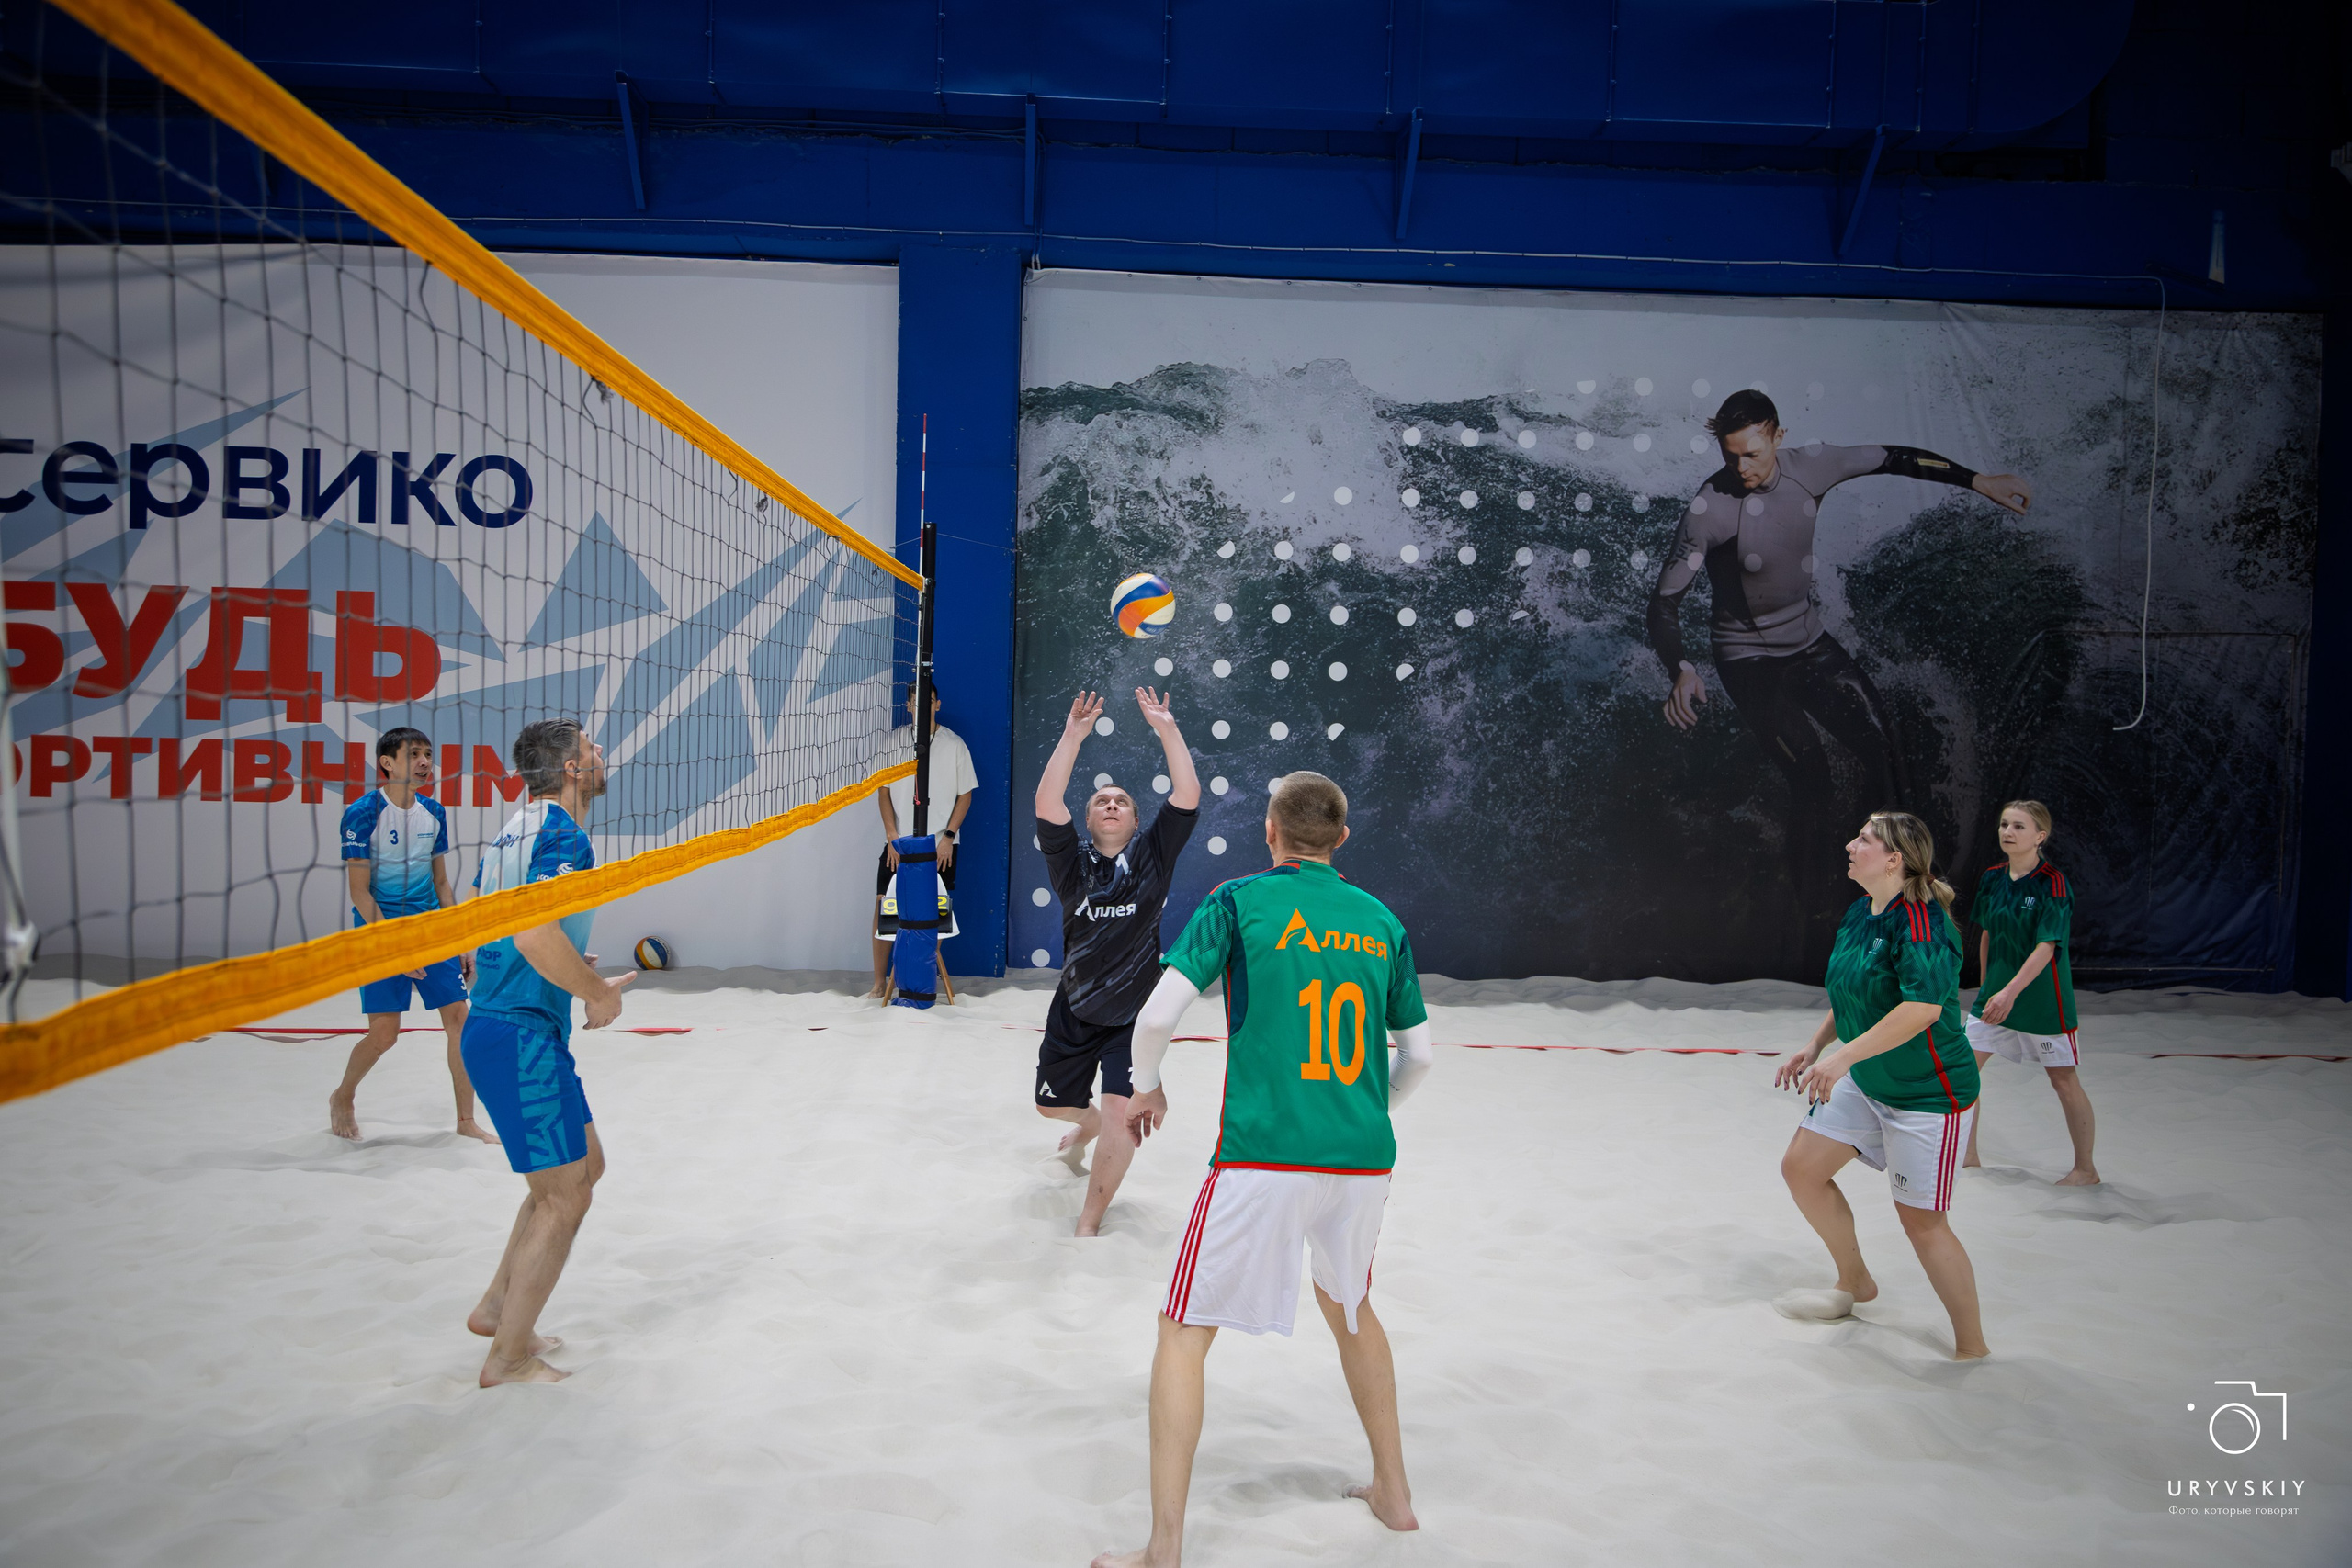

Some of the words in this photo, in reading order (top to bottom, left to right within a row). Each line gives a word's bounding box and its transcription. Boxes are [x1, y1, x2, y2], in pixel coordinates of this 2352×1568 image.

[3, 581, 442, 723] БУДЬ
[0, 734, 533, 807] РТИВНМ
[390, 829, 399, 845] 3
[1074, 894, 1136, 922] Аллея
[1275, 908, 1387, 961] Аллея
[1298, 979, 1366, 1086] 10
